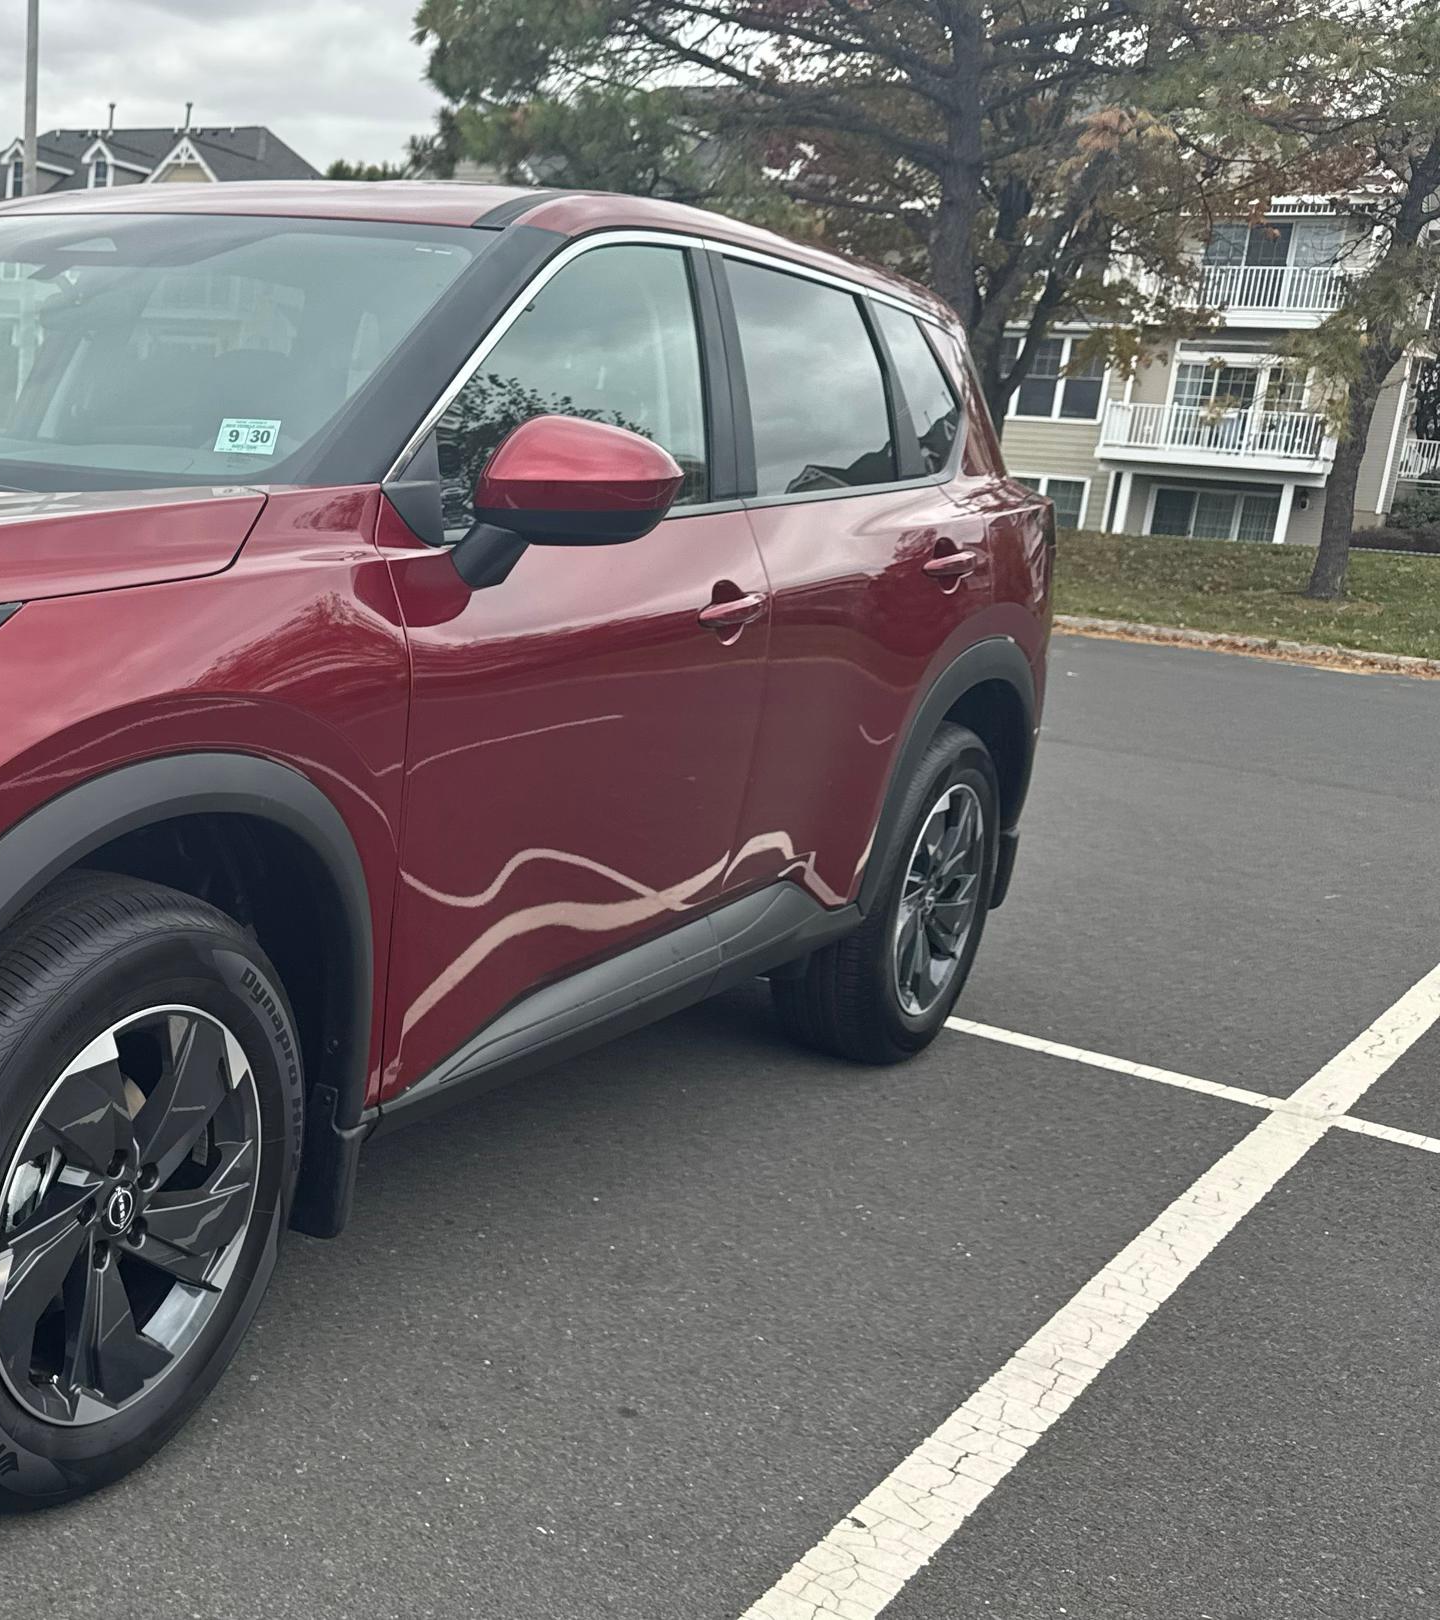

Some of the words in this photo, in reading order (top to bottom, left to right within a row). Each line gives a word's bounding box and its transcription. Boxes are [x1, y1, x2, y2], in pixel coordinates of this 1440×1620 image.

[228, 429, 240, 443] 9
[249, 429, 271, 444] 30
[240, 967, 298, 1086] Dynapro
